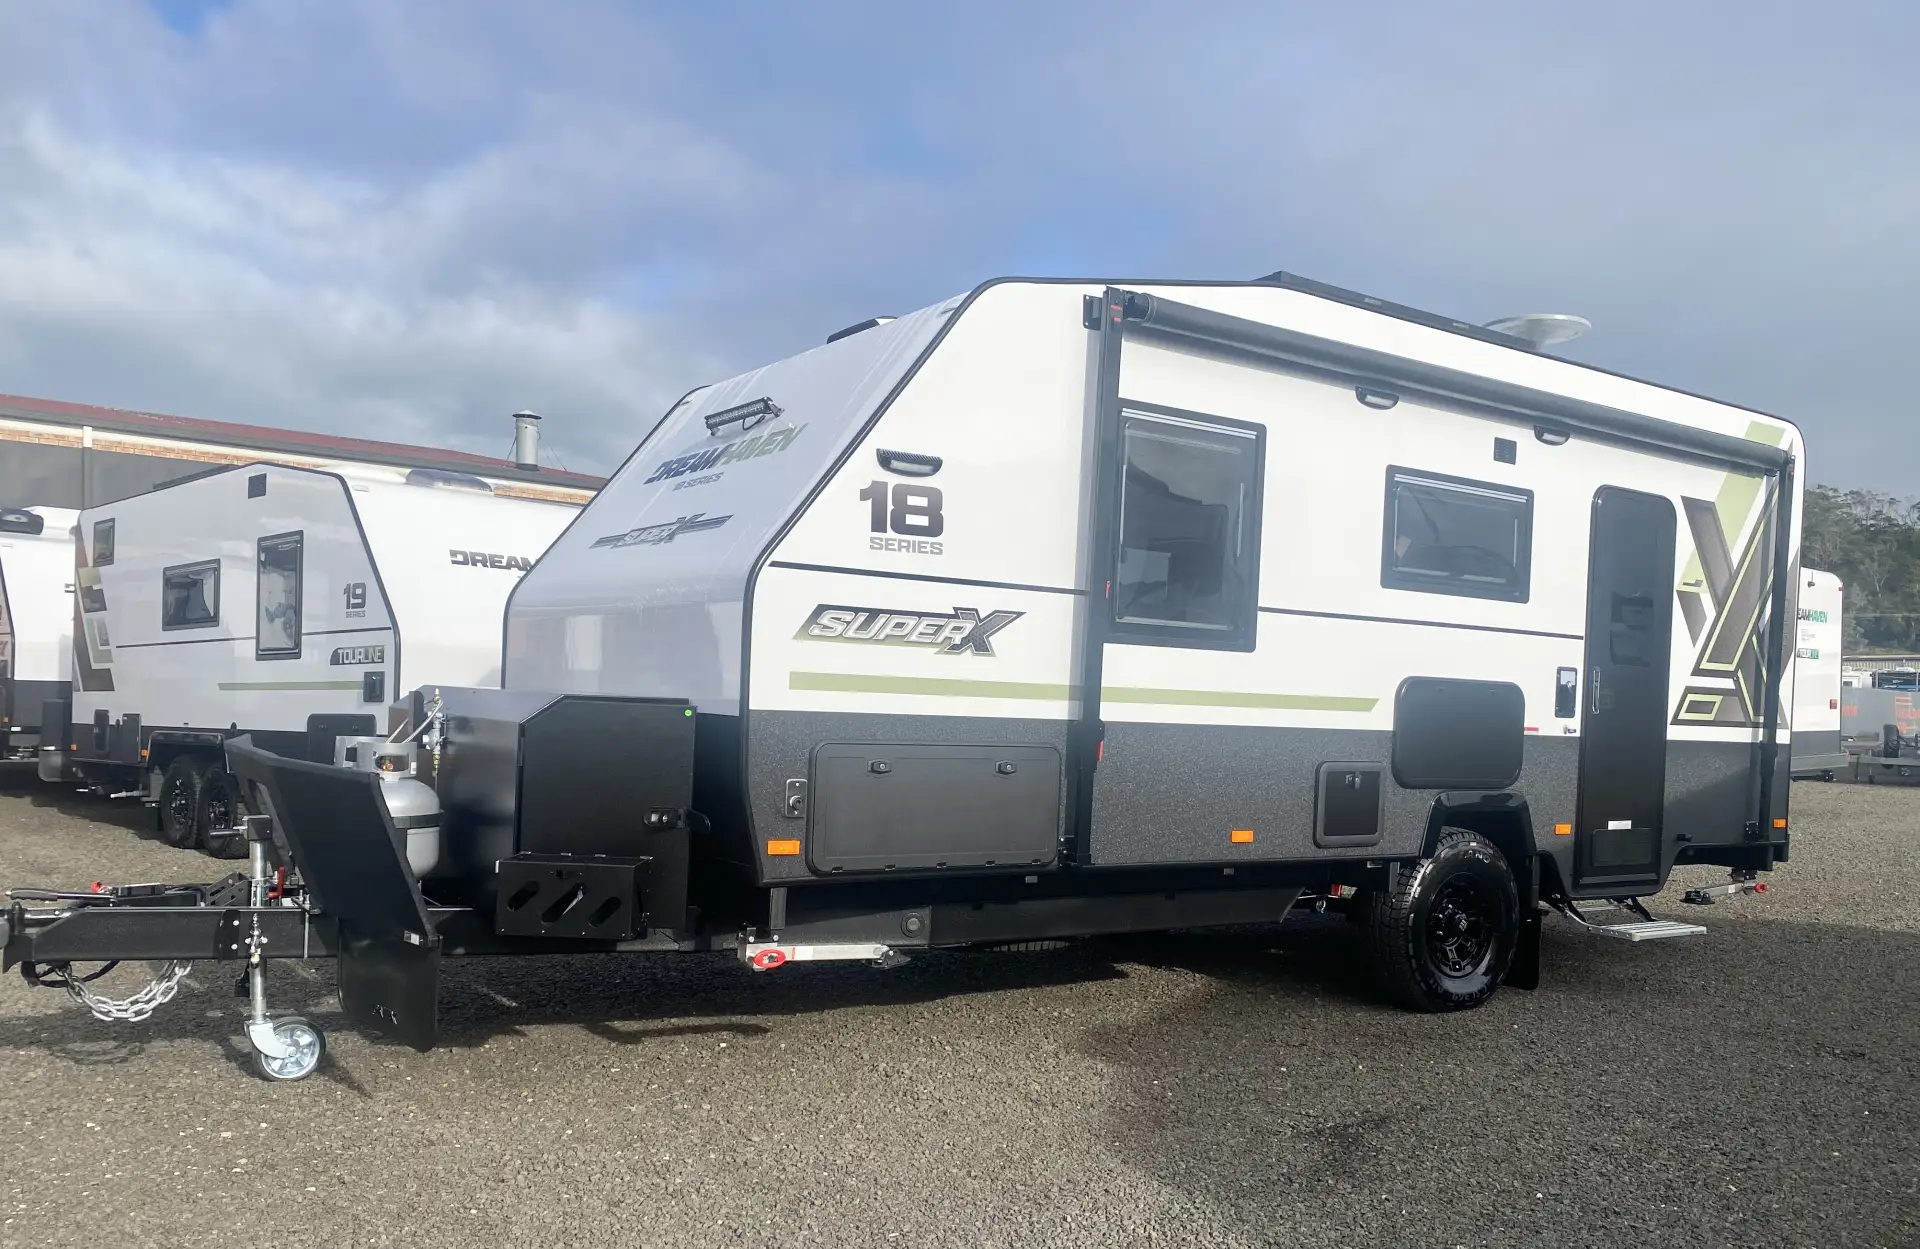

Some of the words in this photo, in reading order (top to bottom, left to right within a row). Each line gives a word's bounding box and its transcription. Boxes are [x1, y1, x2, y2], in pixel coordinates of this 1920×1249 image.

[643, 423, 809, 485] DREAMHAVEN
[683, 472, 724, 489] SERIES
[859, 480, 944, 538] 18
[869, 536, 944, 556] SERIES
[343, 582, 366, 610] 19
[346, 611, 366, 619] SERIES
[338, 646, 384, 664] TOURLINE
